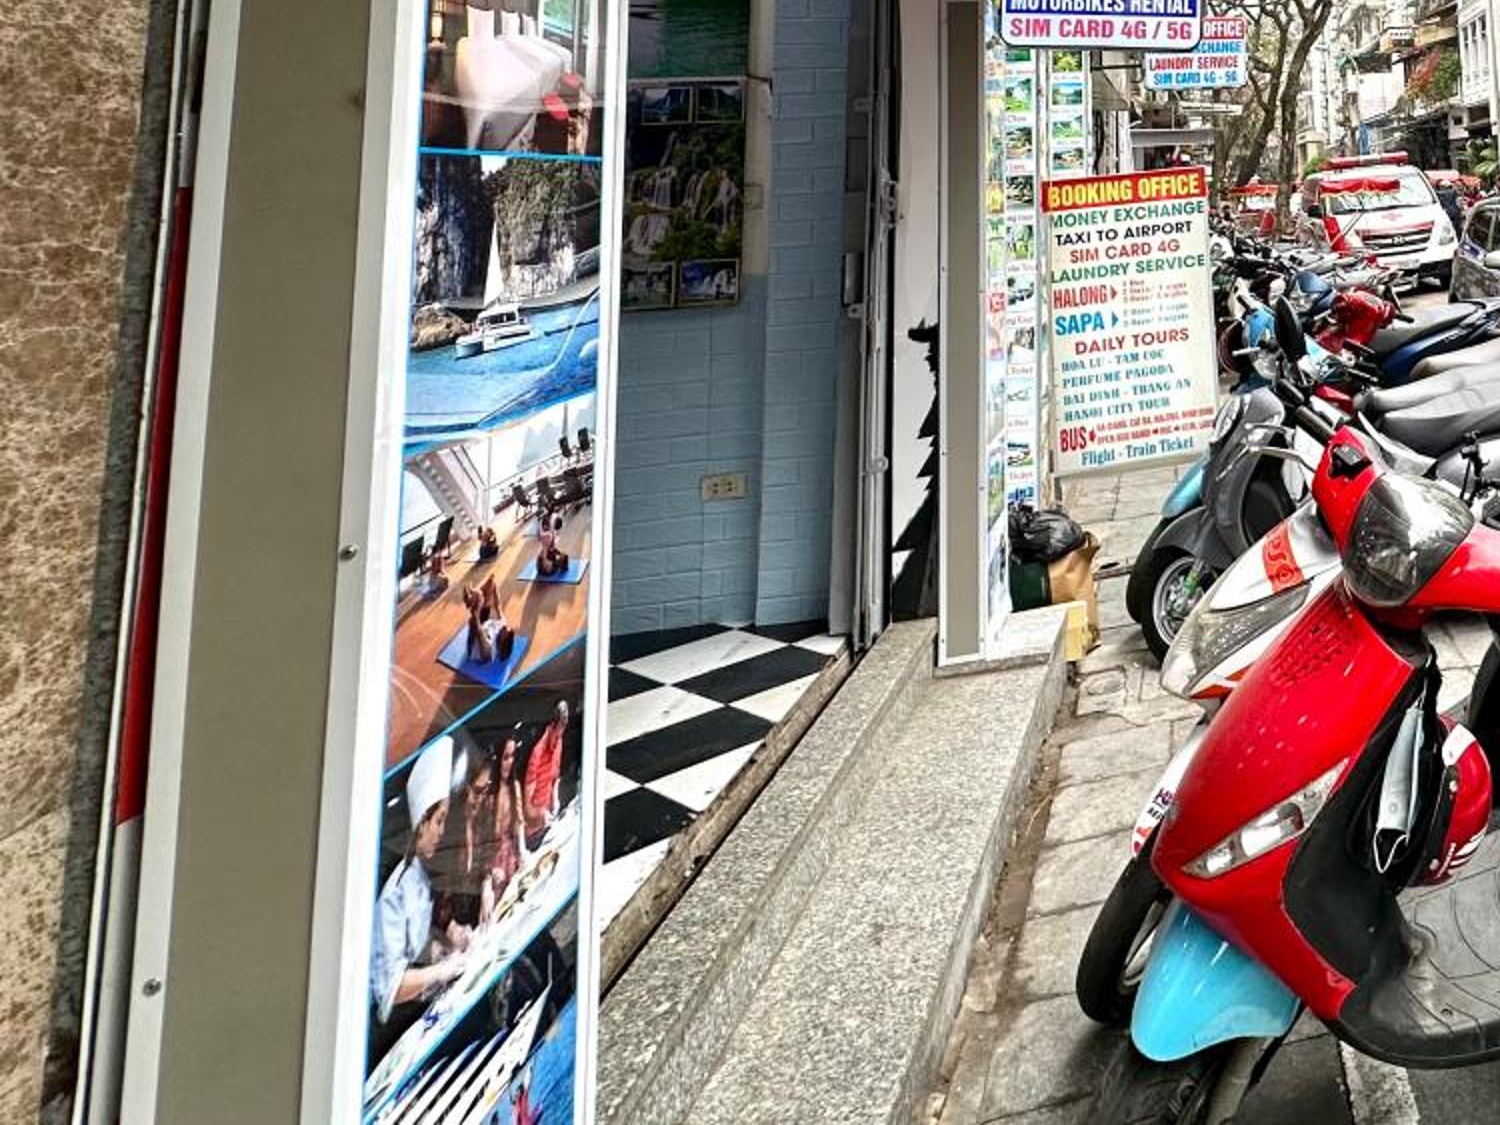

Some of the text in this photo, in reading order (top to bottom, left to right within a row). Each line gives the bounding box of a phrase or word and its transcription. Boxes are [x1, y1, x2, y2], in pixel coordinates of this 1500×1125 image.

[1010, 18, 1050, 38] SIM
[1059, 19, 1114, 39] CARD
[1120, 20, 1147, 40] 4G
[1167, 21, 1192, 40] 5G
[1203, 19, 1243, 39] OFFICE
[1150, 55, 1239, 71] LAUNDRY SERVICE
[1048, 173, 1199, 209] BOOKING OFFICE
[1050, 200, 1205, 228] MONEY EXCHANGE
[1055, 221, 1193, 247] TAXI TO AIRPORT
[1070, 239, 1180, 263] SIM CARD 4G
[1050, 254, 1205, 283] LAUNDRY SERVICE
[1053, 284, 1108, 309] HALONG
[1055, 311, 1105, 336] SAPA
[1075, 328, 1190, 355] DAILY TOURS
[1062, 363, 1174, 389] PERFUME PAGODA
[1107, 402, 1133, 416] CITY
[1059, 426, 1088, 453] BUS
[1081, 448, 1115, 466] Flight
[1126, 443, 1157, 459] Train
[1159, 436, 1194, 453] Ticket
